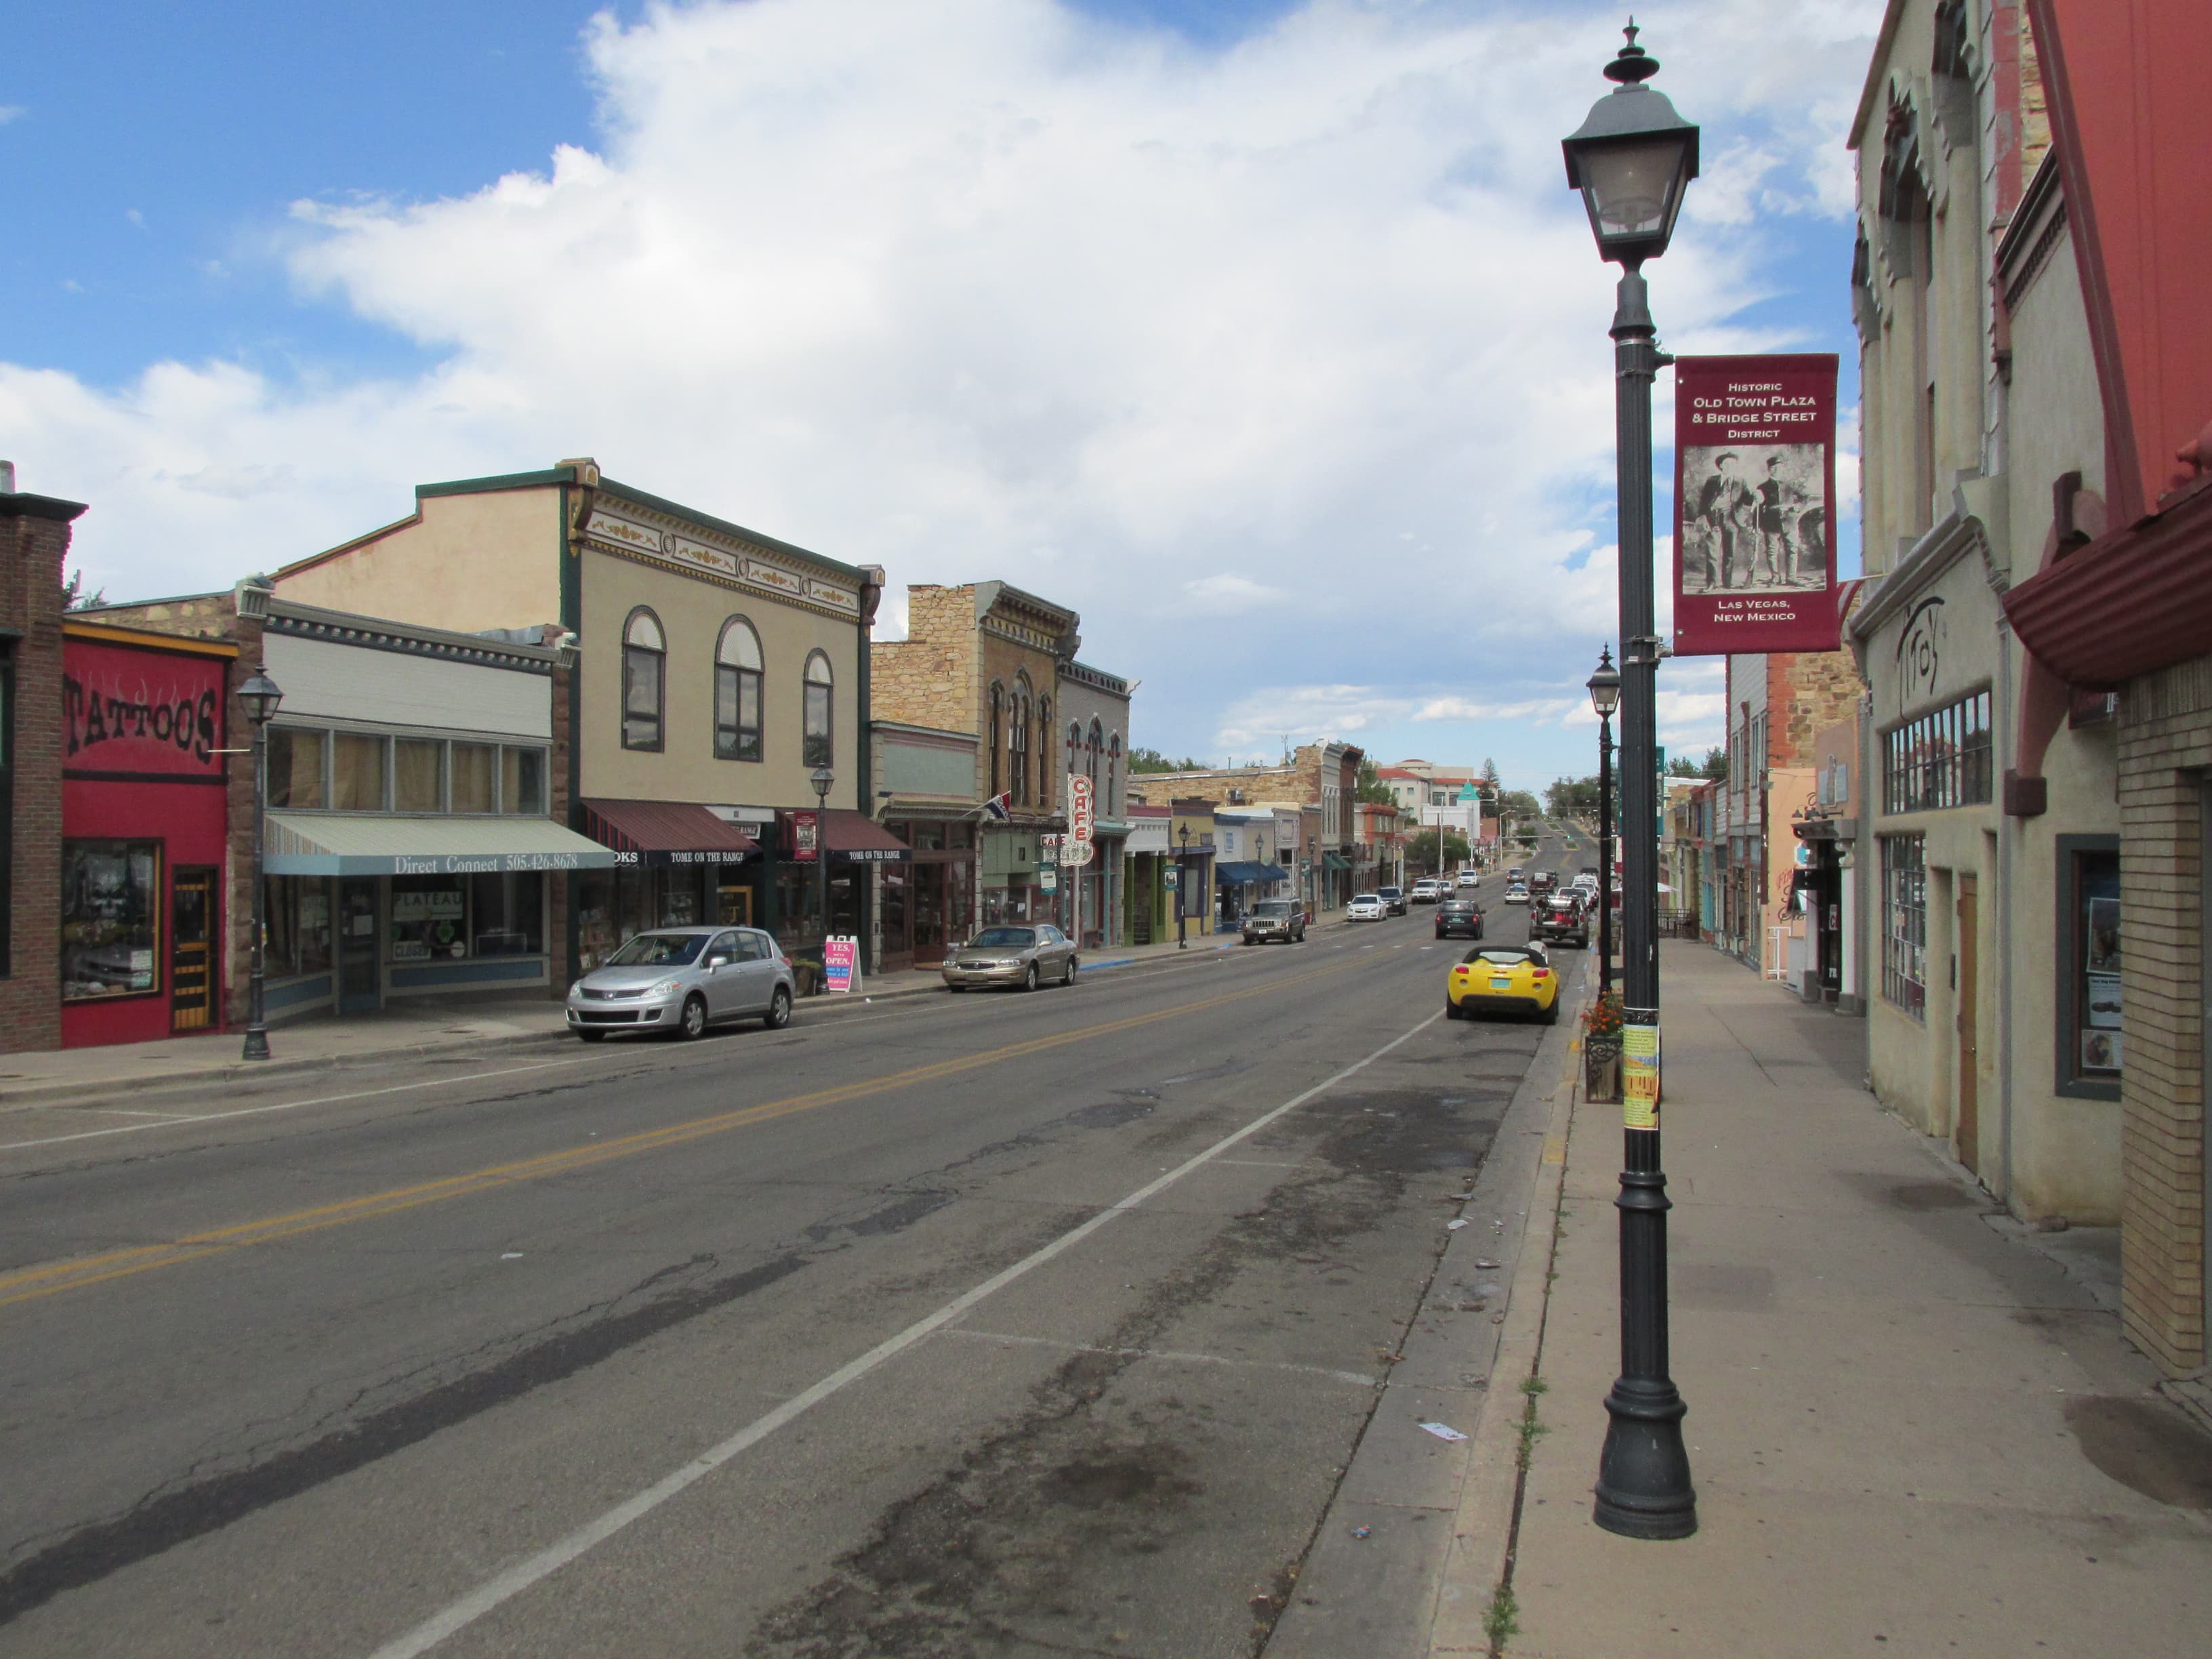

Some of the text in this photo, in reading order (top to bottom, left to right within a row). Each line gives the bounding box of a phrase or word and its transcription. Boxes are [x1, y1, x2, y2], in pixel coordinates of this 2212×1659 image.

[1728, 382, 1783, 392] HISTORIC
[1693, 396, 1816, 408] OLD TOWN PLAZA
[1692, 411, 1817, 424] & BRIDGE STREET
[1727, 429, 1780, 438] DISTRICT
[1718, 600, 1790, 609] LAS VEGAS,
[1713, 613, 1796, 622] NEW MEXICO
[63, 673, 216, 765] TATTOOS
[1073, 779, 1088, 841] CAFE
[671, 852, 692, 863] TOME
[695, 852, 705, 862] ON
[706, 852, 720, 862] THE
[849, 851, 900, 860] TOME ON THE RANGE
[395, 855, 438, 874] Direct
[446, 854, 498, 872] Connect
[394, 893, 462, 906] PLATEAU
[832, 944, 851, 952] YES,
[825, 957, 850, 965] OPEN.
